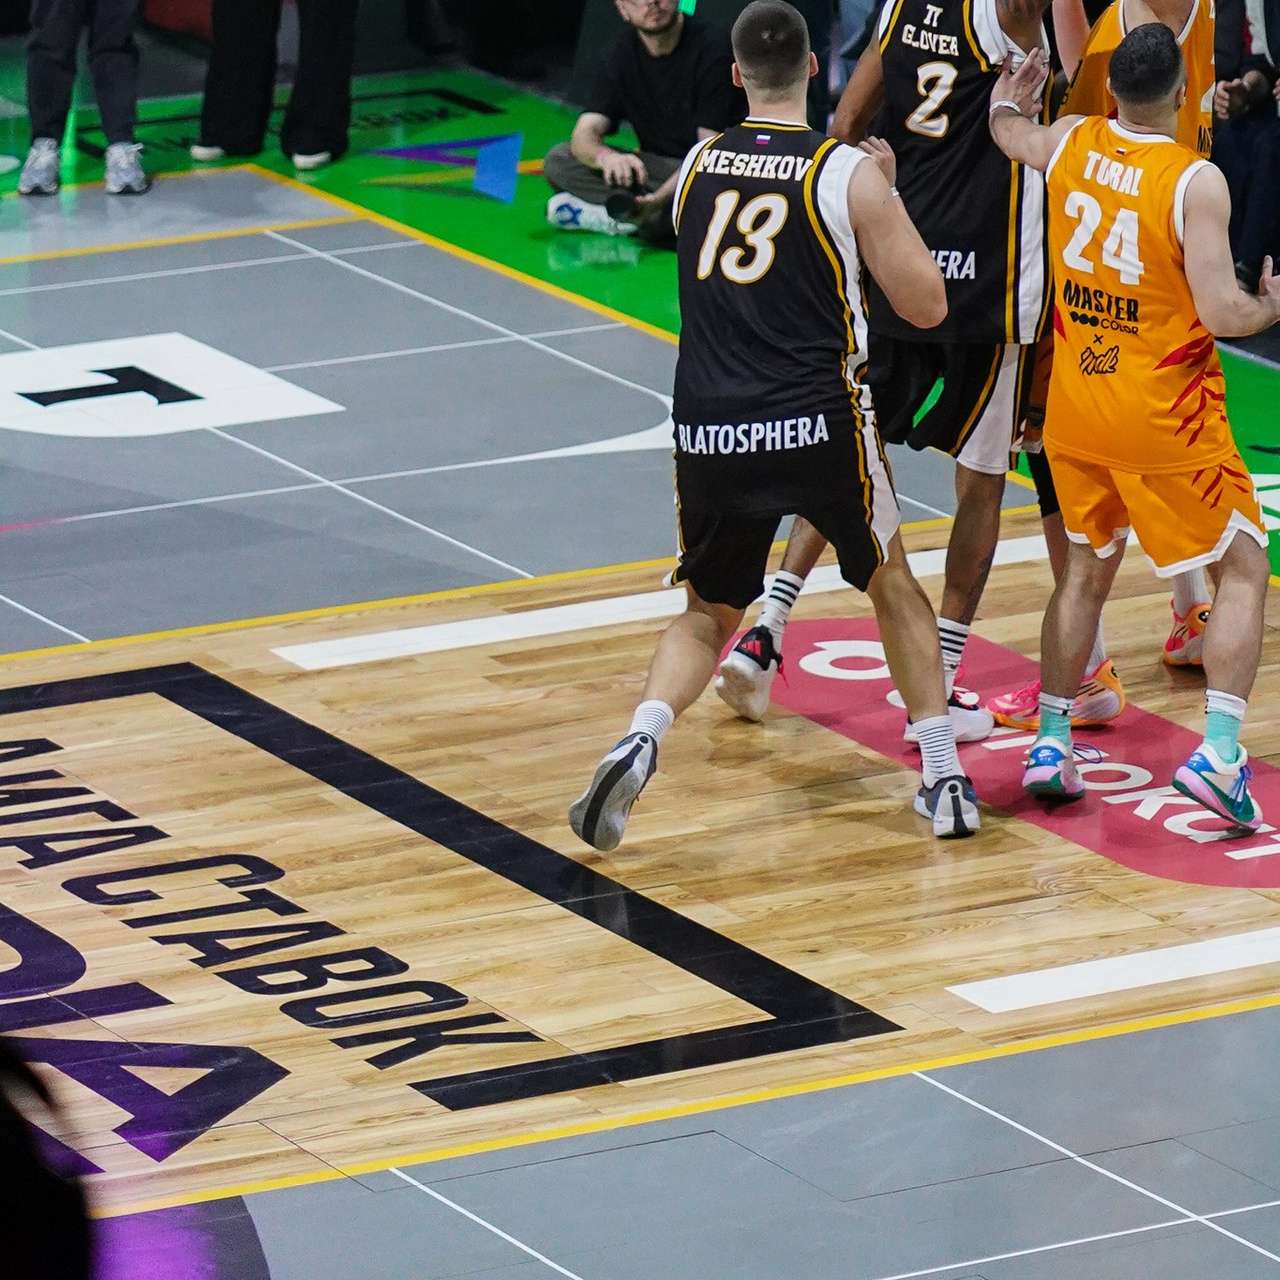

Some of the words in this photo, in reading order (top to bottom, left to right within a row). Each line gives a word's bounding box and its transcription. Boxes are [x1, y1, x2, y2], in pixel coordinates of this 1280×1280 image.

[905, 60, 959, 138] 2
[696, 148, 815, 182] MESHKOV
[1083, 150, 1145, 197] TURAL
[697, 189, 789, 285] 13
[1062, 191, 1145, 286] 24
[1063, 279, 1140, 323] MASTER
[1100, 318, 1140, 336] COLOR
[15, 365, 207, 408] 1
[678, 413, 830, 455] BLATOSPHERA
[62, 853, 547, 1071] СТАВОК
